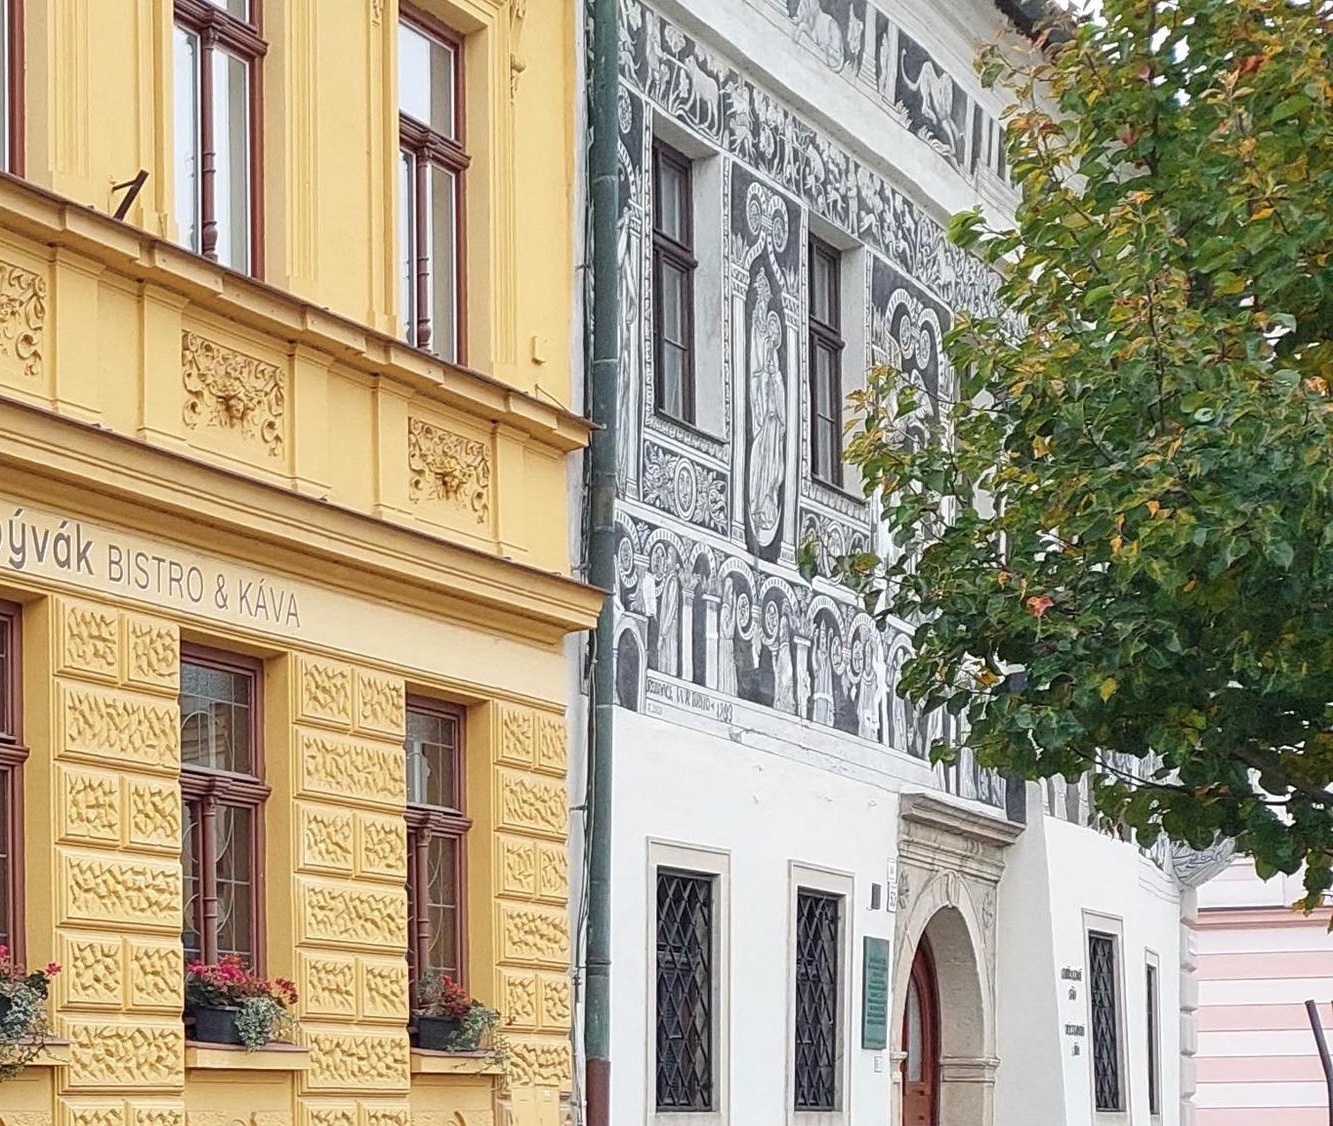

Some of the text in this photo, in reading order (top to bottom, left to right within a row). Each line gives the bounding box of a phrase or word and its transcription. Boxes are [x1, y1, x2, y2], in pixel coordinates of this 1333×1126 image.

[108, 543, 205, 604] BISTRO
[215, 573, 229, 610] &
[238, 578, 302, 628] KÁVA
